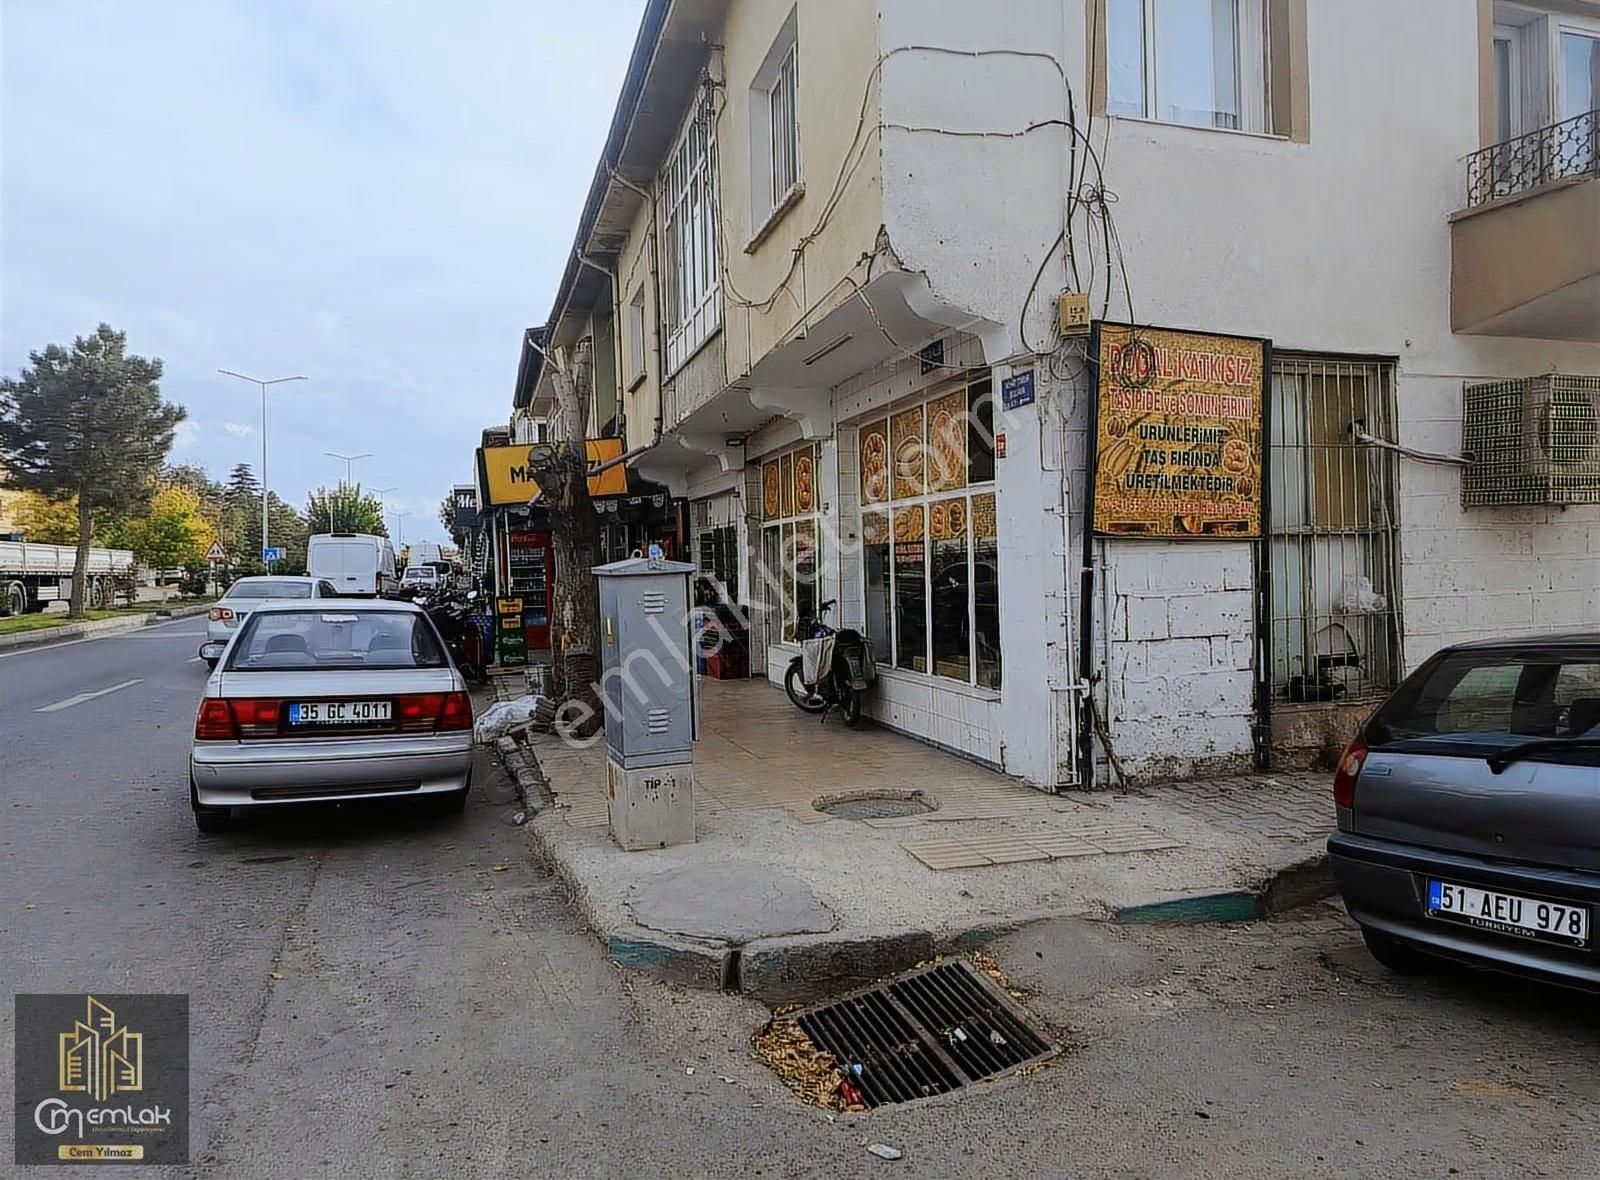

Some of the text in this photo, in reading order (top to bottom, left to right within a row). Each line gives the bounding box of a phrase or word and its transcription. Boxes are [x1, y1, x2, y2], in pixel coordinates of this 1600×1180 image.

[1178, 350, 1253, 386] KATKISIZ
[1179, 395, 1219, 417] SOMUN
[1170, 450, 1220, 468] FIRINDA
[300, 704, 319, 720] 35
[327, 703, 346, 719] GC
[353, 703, 388, 718] 4011
[1442, 886, 1465, 913] 51
[1480, 893, 1522, 924] AEU
[1537, 904, 1582, 935] 978
